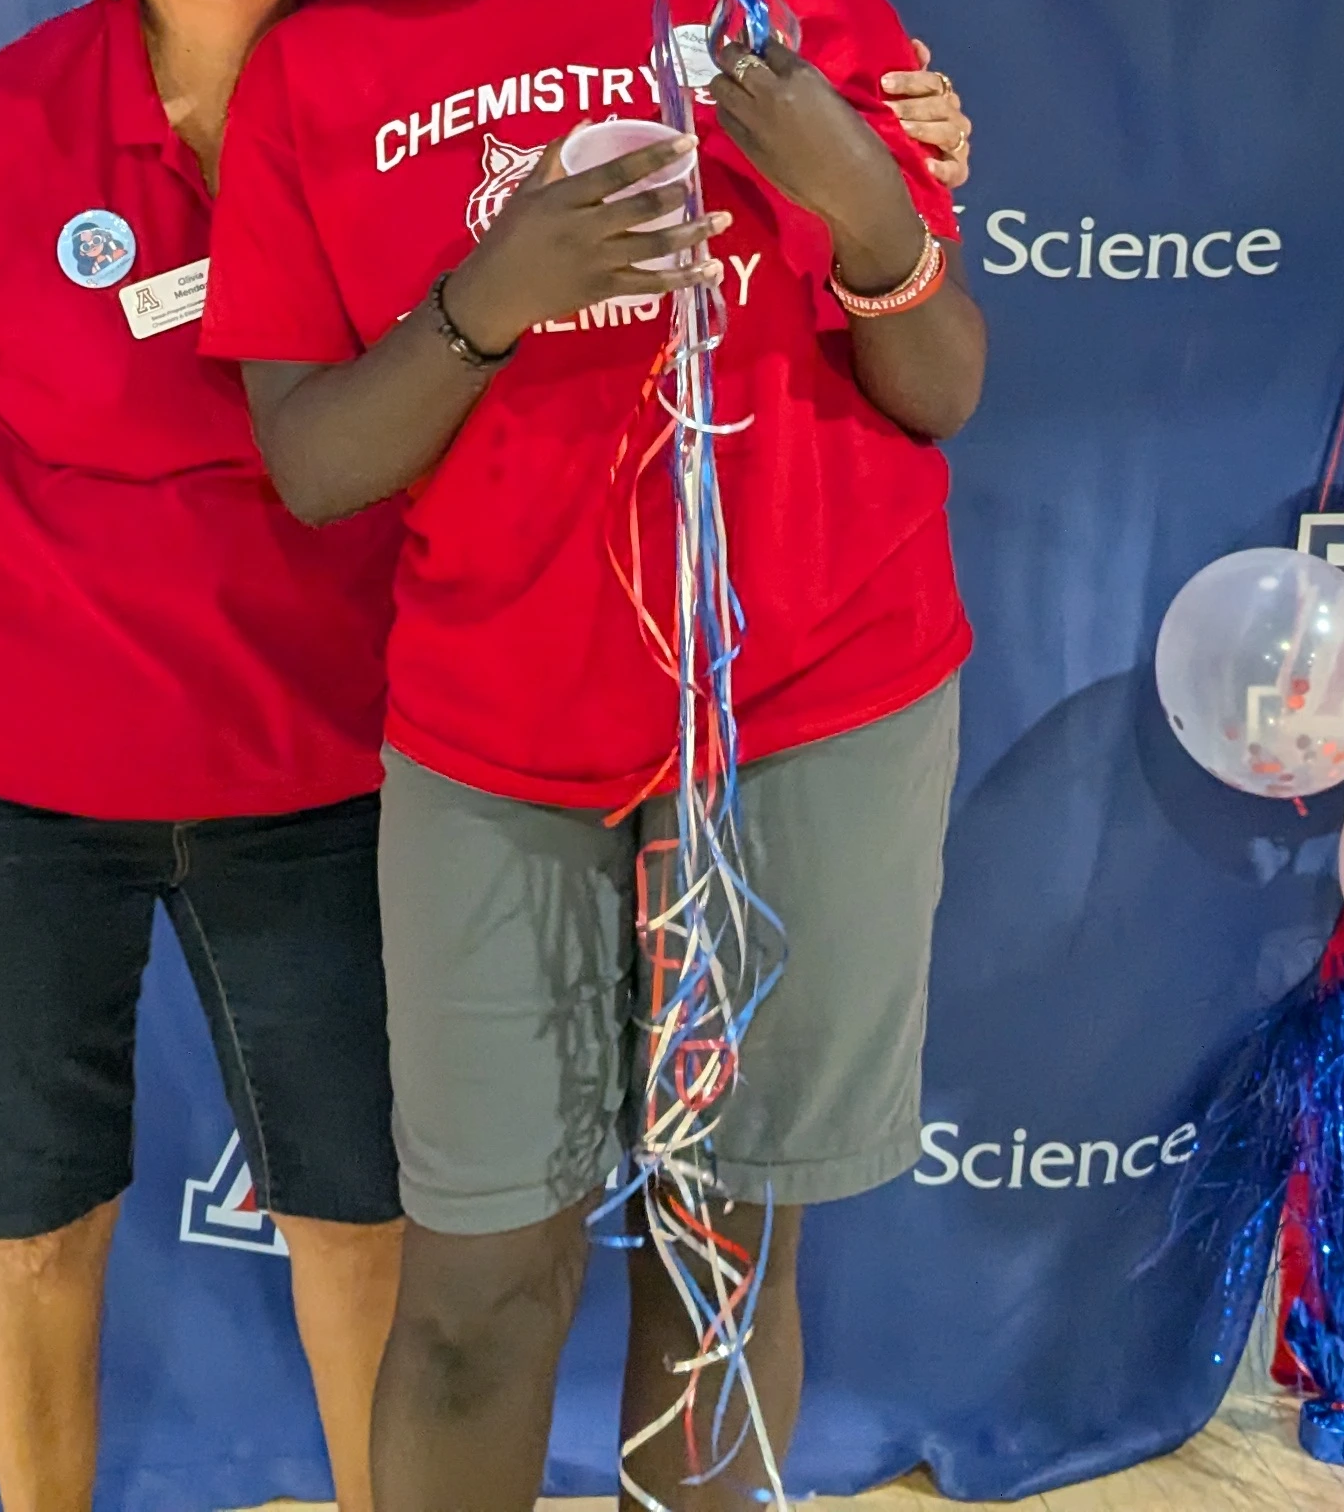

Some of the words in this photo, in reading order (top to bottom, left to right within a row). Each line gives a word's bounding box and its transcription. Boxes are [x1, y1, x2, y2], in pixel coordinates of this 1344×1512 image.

[375, 64, 661, 173] CHEMISTRY
[982, 208, 1282, 280] Science
[913, 1121, 1197, 1189] Science
